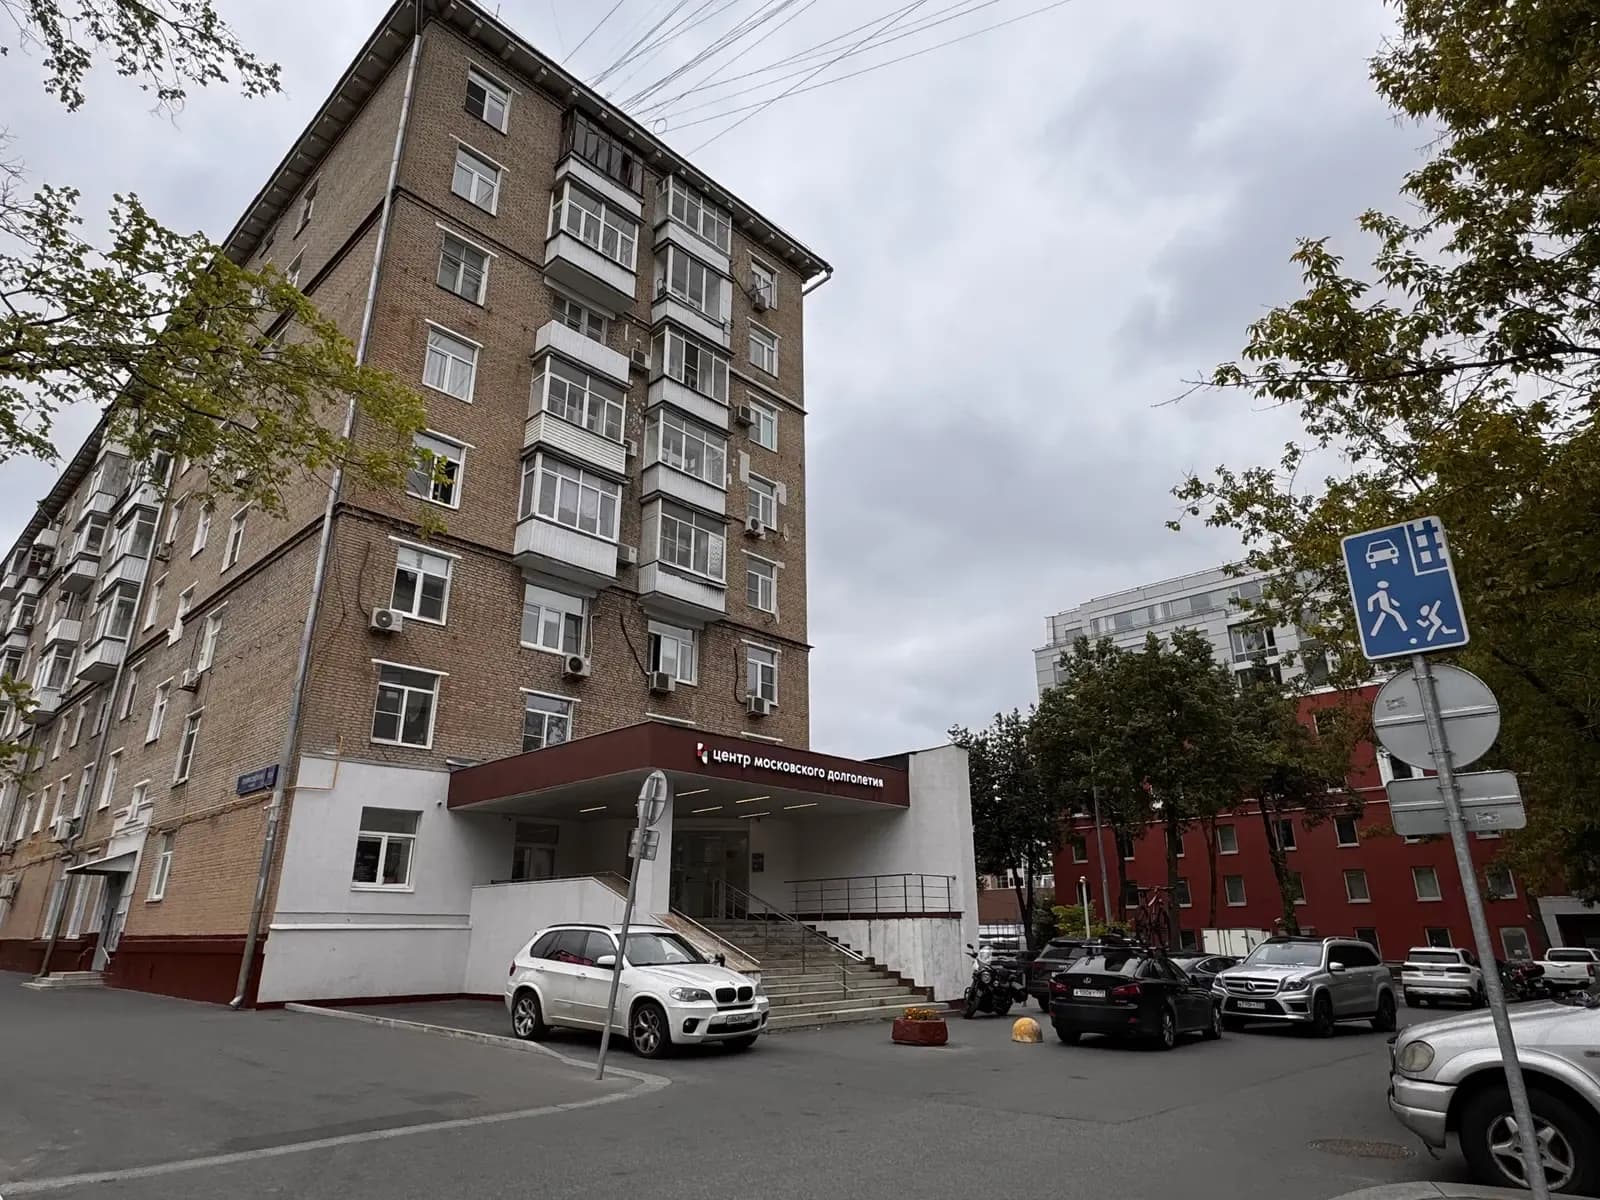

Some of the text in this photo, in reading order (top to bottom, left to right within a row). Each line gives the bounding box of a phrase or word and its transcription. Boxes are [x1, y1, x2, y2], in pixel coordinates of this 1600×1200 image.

[713, 749, 884, 788] центр московского долголетия
